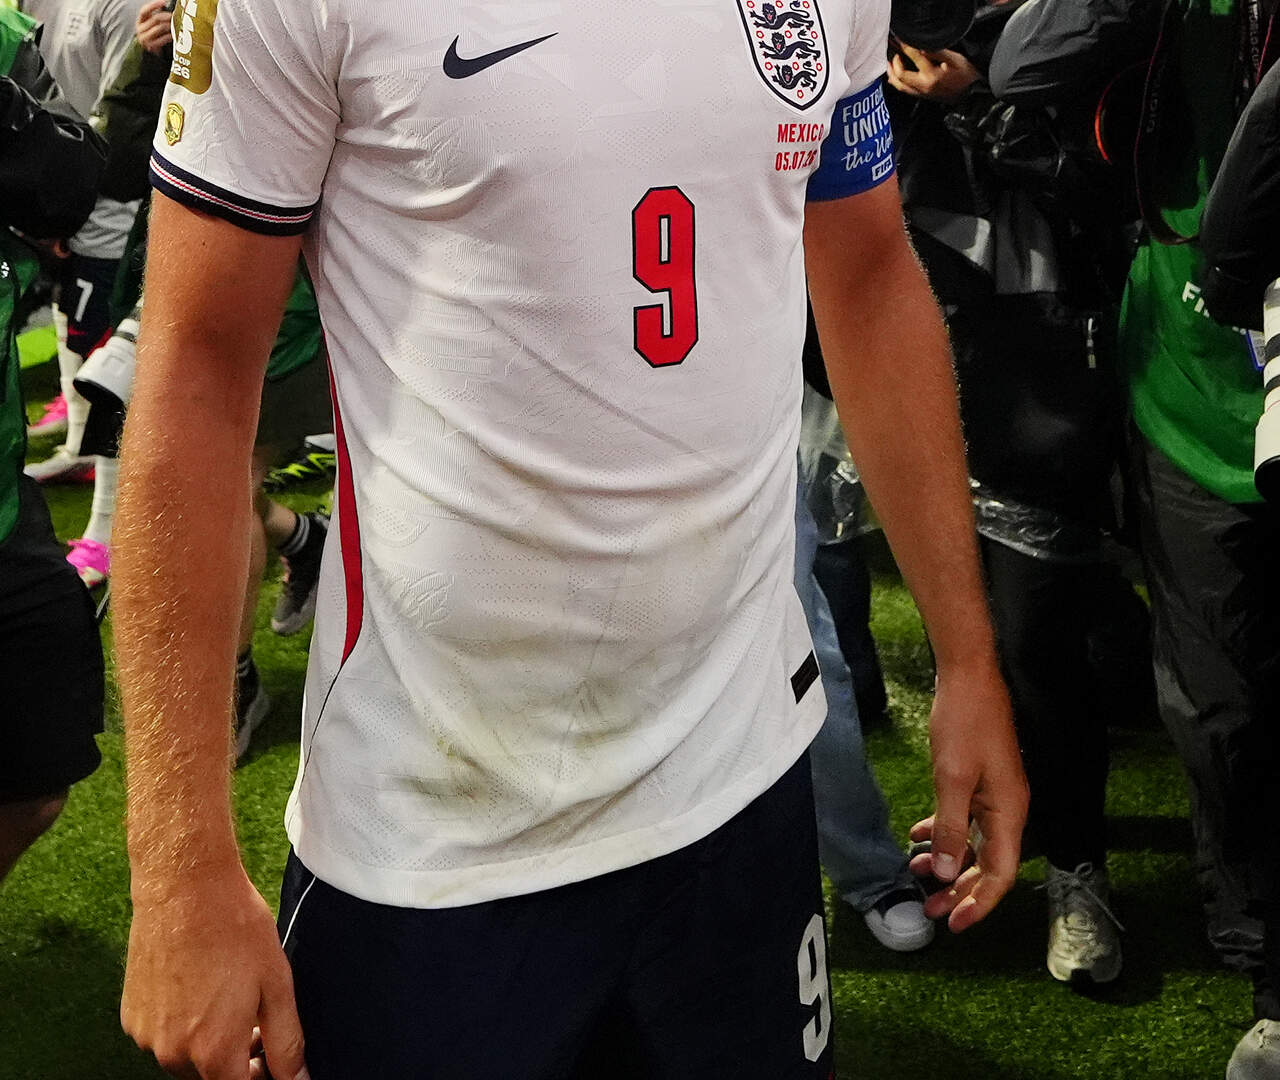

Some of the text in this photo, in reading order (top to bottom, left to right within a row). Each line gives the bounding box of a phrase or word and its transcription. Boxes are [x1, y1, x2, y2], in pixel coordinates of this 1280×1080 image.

[841, 147, 874, 171] the
[74, 277, 94, 322] 7
[631, 185, 699, 368] 9
[797, 912, 832, 1063] 9
